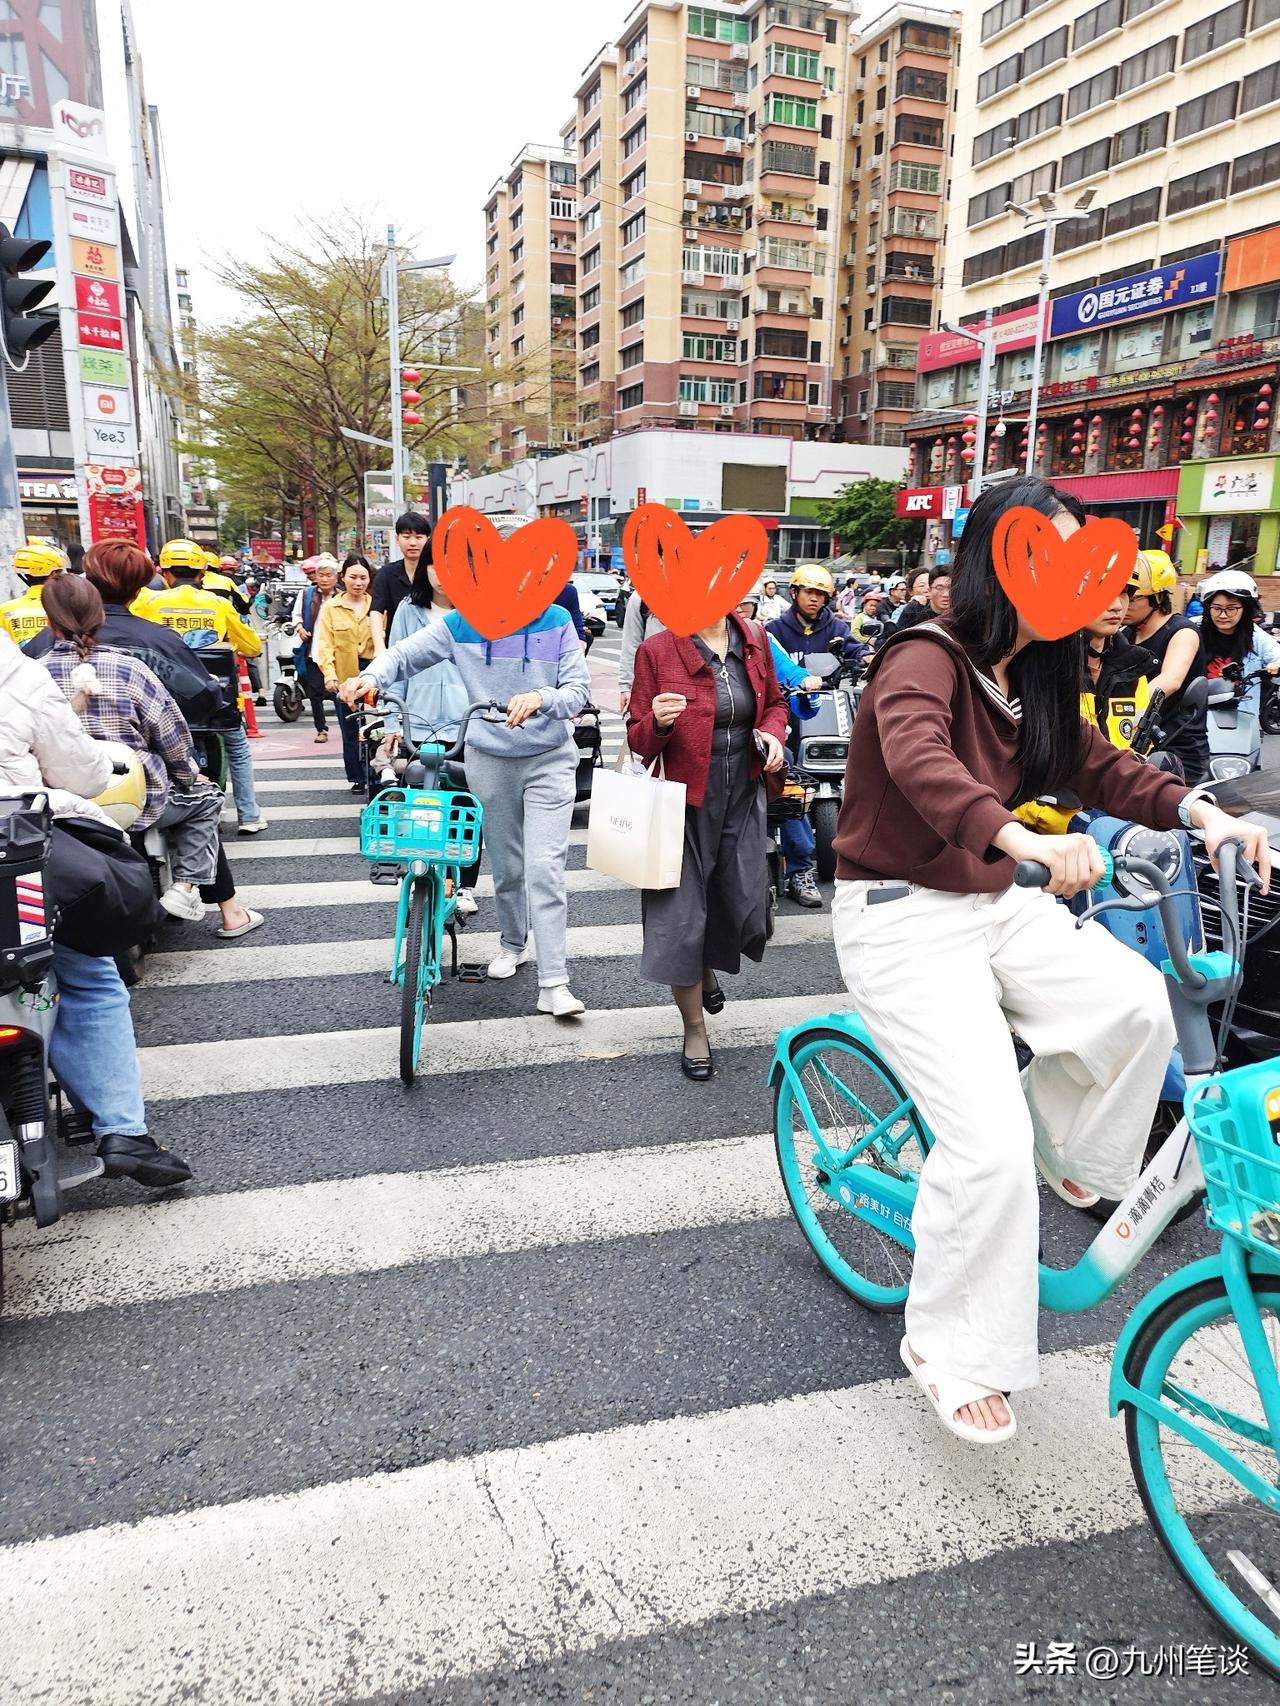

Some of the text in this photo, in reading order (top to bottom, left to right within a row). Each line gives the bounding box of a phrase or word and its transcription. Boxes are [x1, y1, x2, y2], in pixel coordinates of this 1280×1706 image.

[1098, 276, 1164, 310] 国元证券
[94, 428, 126, 443] Yee3
[19, 482, 61, 498] TEA
[906, 494, 933, 511] KFC
[162, 616, 215, 630] 美食团购
[850, 1190, 891, 1219] 一路美好
[1128, 1176, 1166, 1226] 滴滴青桔
